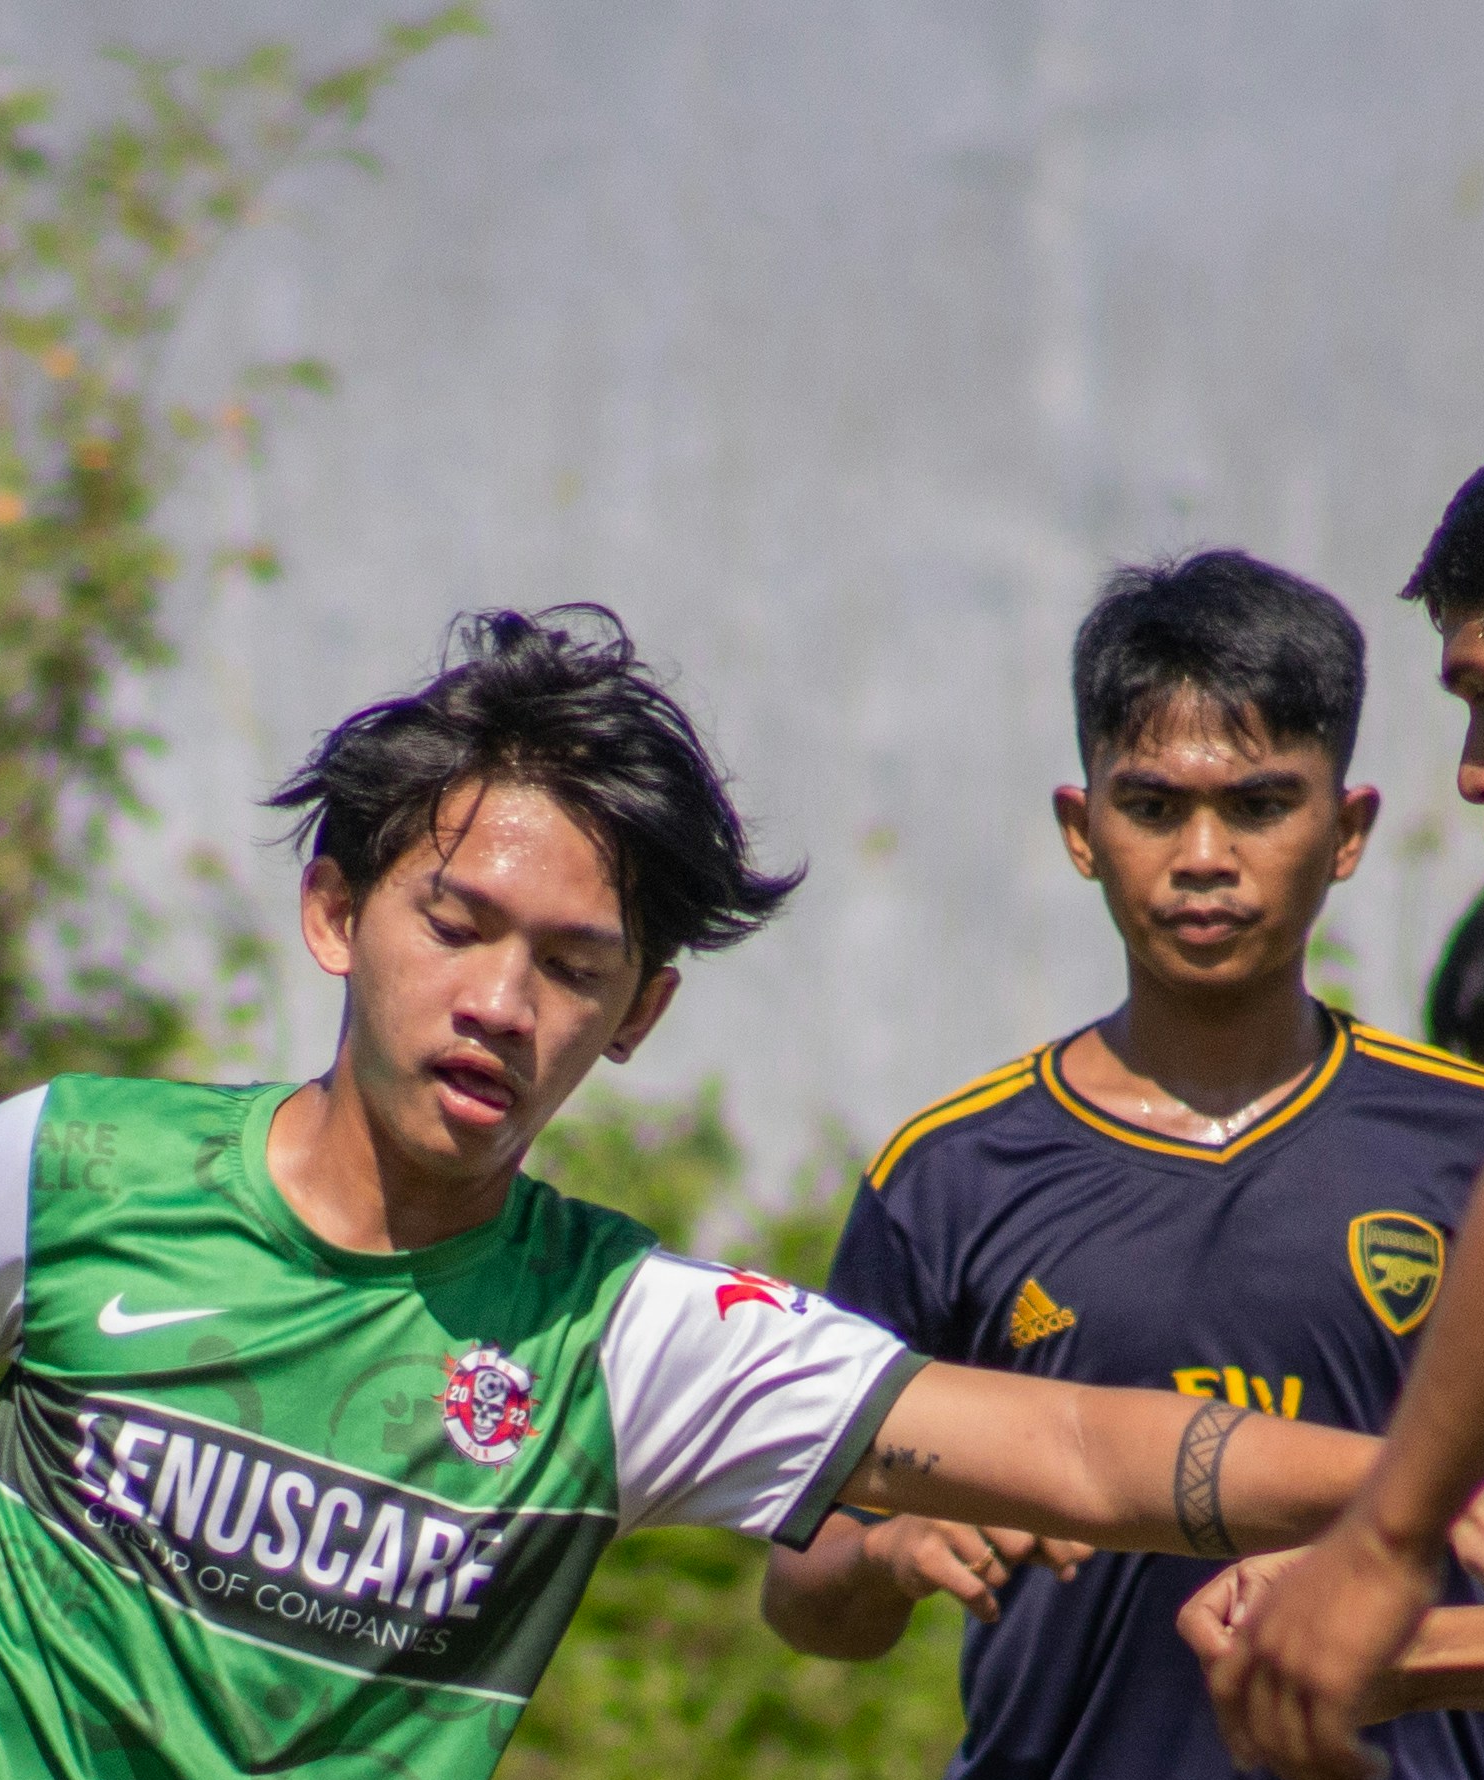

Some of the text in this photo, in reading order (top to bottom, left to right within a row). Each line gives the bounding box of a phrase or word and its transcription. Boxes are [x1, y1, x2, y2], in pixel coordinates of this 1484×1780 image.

[1011, 1309, 1075, 1348] adidas
[449, 1385, 469, 1403] 20
[509, 1407, 526, 1426] 22
[74, 1412, 504, 1619] LENUSCARE
[198, 1566, 251, 1598] OF
[255, 1584, 451, 1655] COMPANIES
